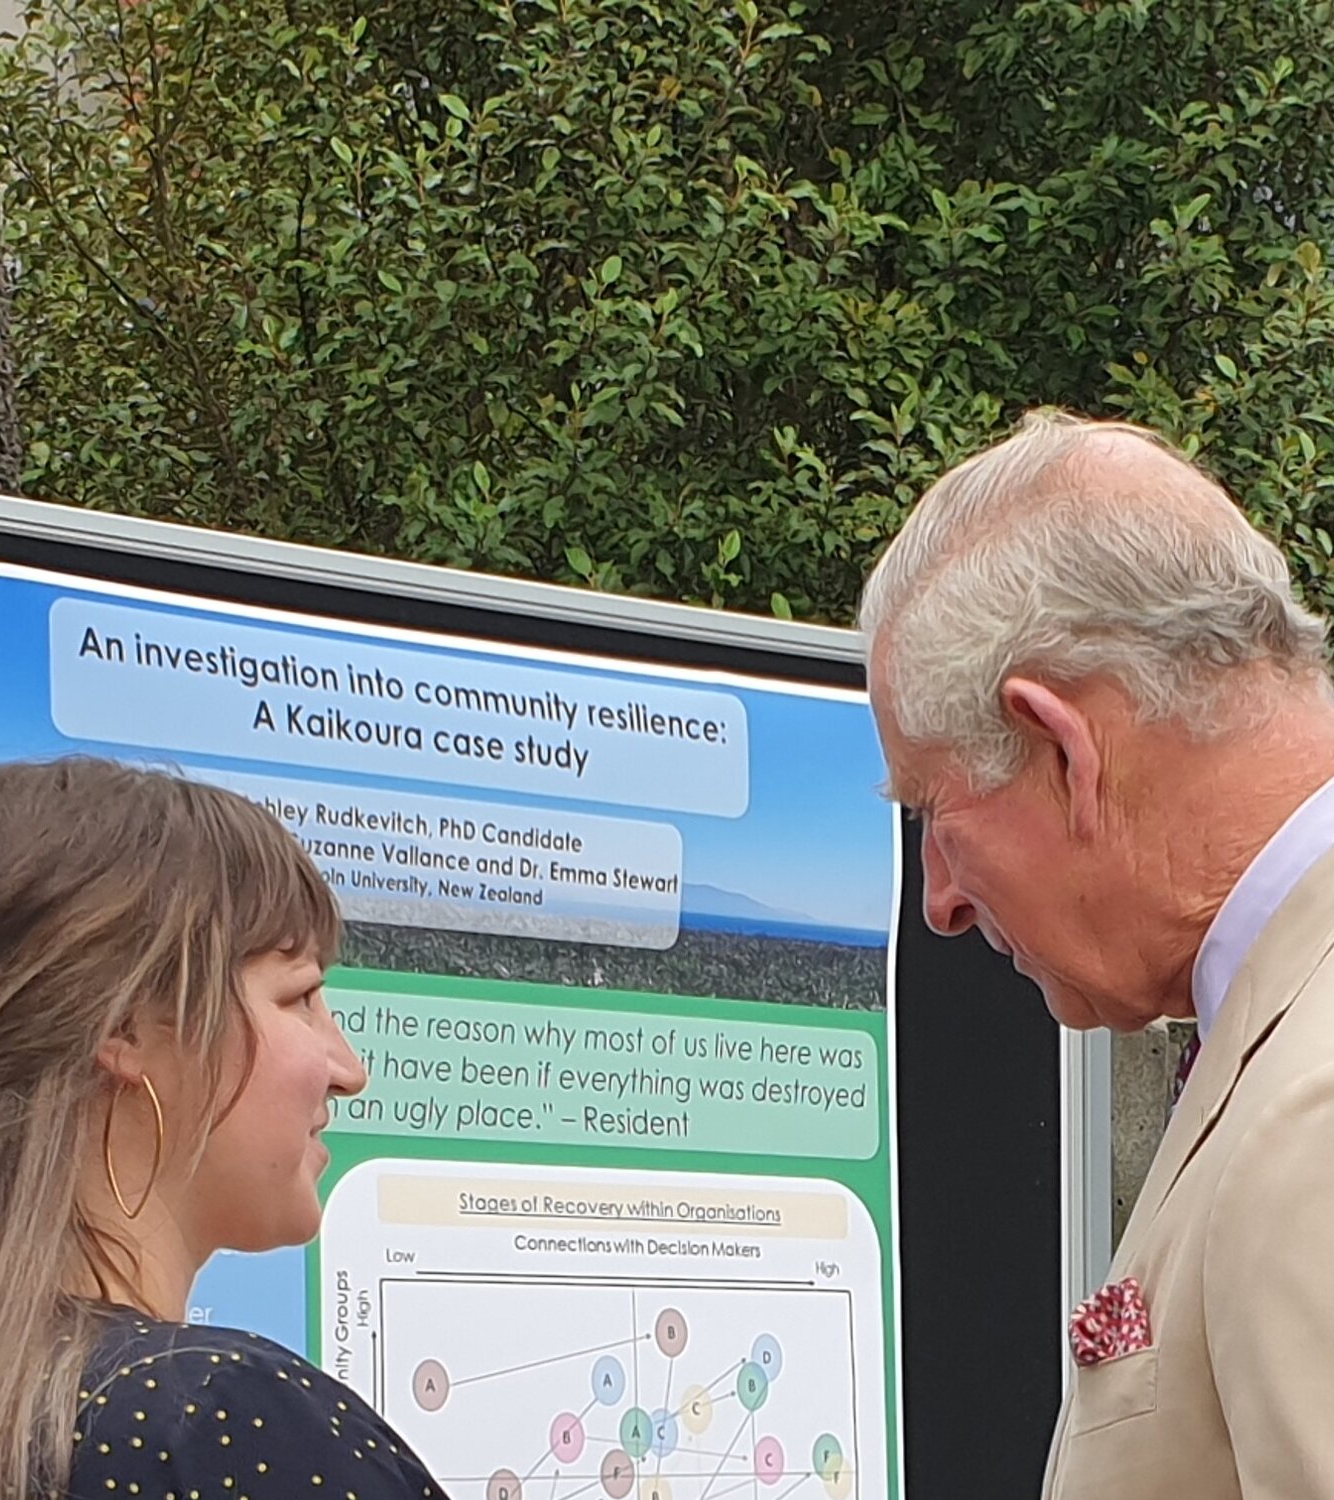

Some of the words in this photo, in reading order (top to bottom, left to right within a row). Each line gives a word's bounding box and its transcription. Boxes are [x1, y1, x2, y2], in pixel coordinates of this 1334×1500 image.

[79, 626, 124, 662] An
[135, 634, 339, 692] investigation
[347, 664, 404, 700] into
[415, 680, 577, 730] community
[588, 701, 727, 744] resilience:
[252, 700, 275, 732] A
[287, 703, 422, 750] Kaikoura
[434, 730, 504, 760] case
[514, 735, 589, 777] study
[257, 796, 308, 827] hley
[316, 803, 432, 838] Rudkevitch,
[439, 818, 475, 840] PhD
[482, 823, 583, 853] Candidate
[351, 870, 432, 898] University,
[438, 880, 473, 898] New
[479, 884, 543, 905] Zealand
[382, 842, 470, 871] Vallance
[476, 857, 513, 876] and
[520, 858, 543, 881] Dr.
[550, 862, 608, 887] Emma
[613, 868, 679, 895] Stewart
[331, 1006, 366, 1034] nd
[376, 1007, 418, 1036] the
[427, 1017, 515, 1044] reason
[524, 1020, 576, 1055] why
[584, 1026, 643, 1053] most
[652, 1029, 676, 1055] of
[684, 1037, 708, 1058] us
[715, 1033, 752, 1061] live
[760, 1037, 811, 1065] here
[819, 1048, 863, 1069] was
[383, 1051, 452, 1082] have
[461, 1057, 529, 1087] been
[537, 1061, 551, 1089] if
[559, 1067, 691, 1103] everything
[699, 1078, 744, 1100] was
[752, 1077, 866, 1113] destroyed
[348, 1098, 383, 1120] an
[394, 1097, 449, 1130] ugly
[456, 1099, 554, 1131] place."
[584, 1106, 690, 1137] Resident
[459, 1193, 517, 1214] Stages
[521, 1197, 538, 1214] of
[543, 1196, 623, 1219] Recovery
[627, 1199, 673, 1219] within
[677, 1203, 781, 1223] Organisations
[386, 1248, 415, 1262] Low
[514, 1235, 612, 1254] Connections
[614, 1237, 644, 1255] with
[647, 1239, 709, 1257] Decision
[712, 1241, 761, 1259] Makers
[815, 1260, 841, 1278] High
[335, 1270, 352, 1342] Groups
[357, 1290, 371, 1327] High
[425, 1378, 436, 1393] A
